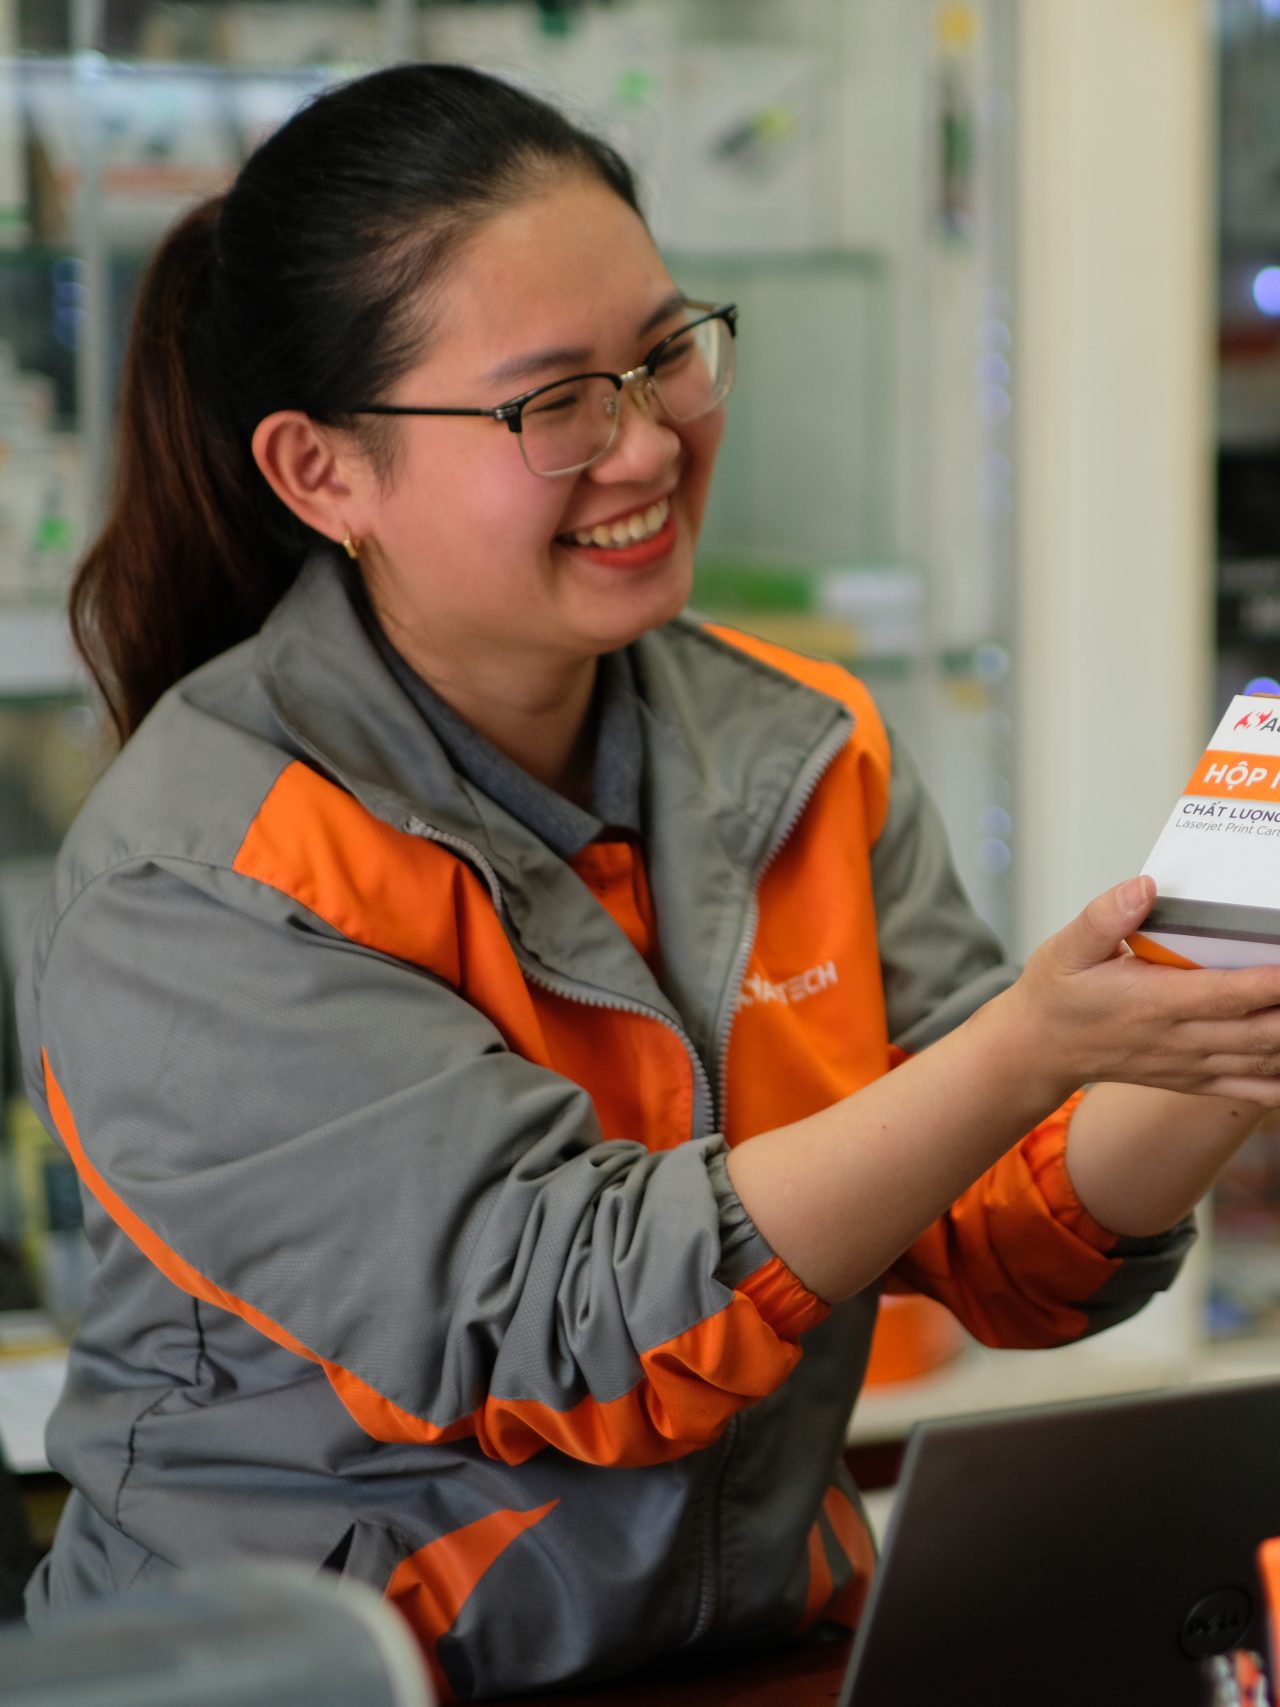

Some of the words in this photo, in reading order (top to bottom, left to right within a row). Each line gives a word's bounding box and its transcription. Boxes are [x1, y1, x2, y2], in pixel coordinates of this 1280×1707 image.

[1203, 760, 1268, 791] HỘP
[1182, 801, 1228, 817] CHẤT
[1175, 818, 1222, 832] Laserjet
[1225, 822, 1254, 834] Print
